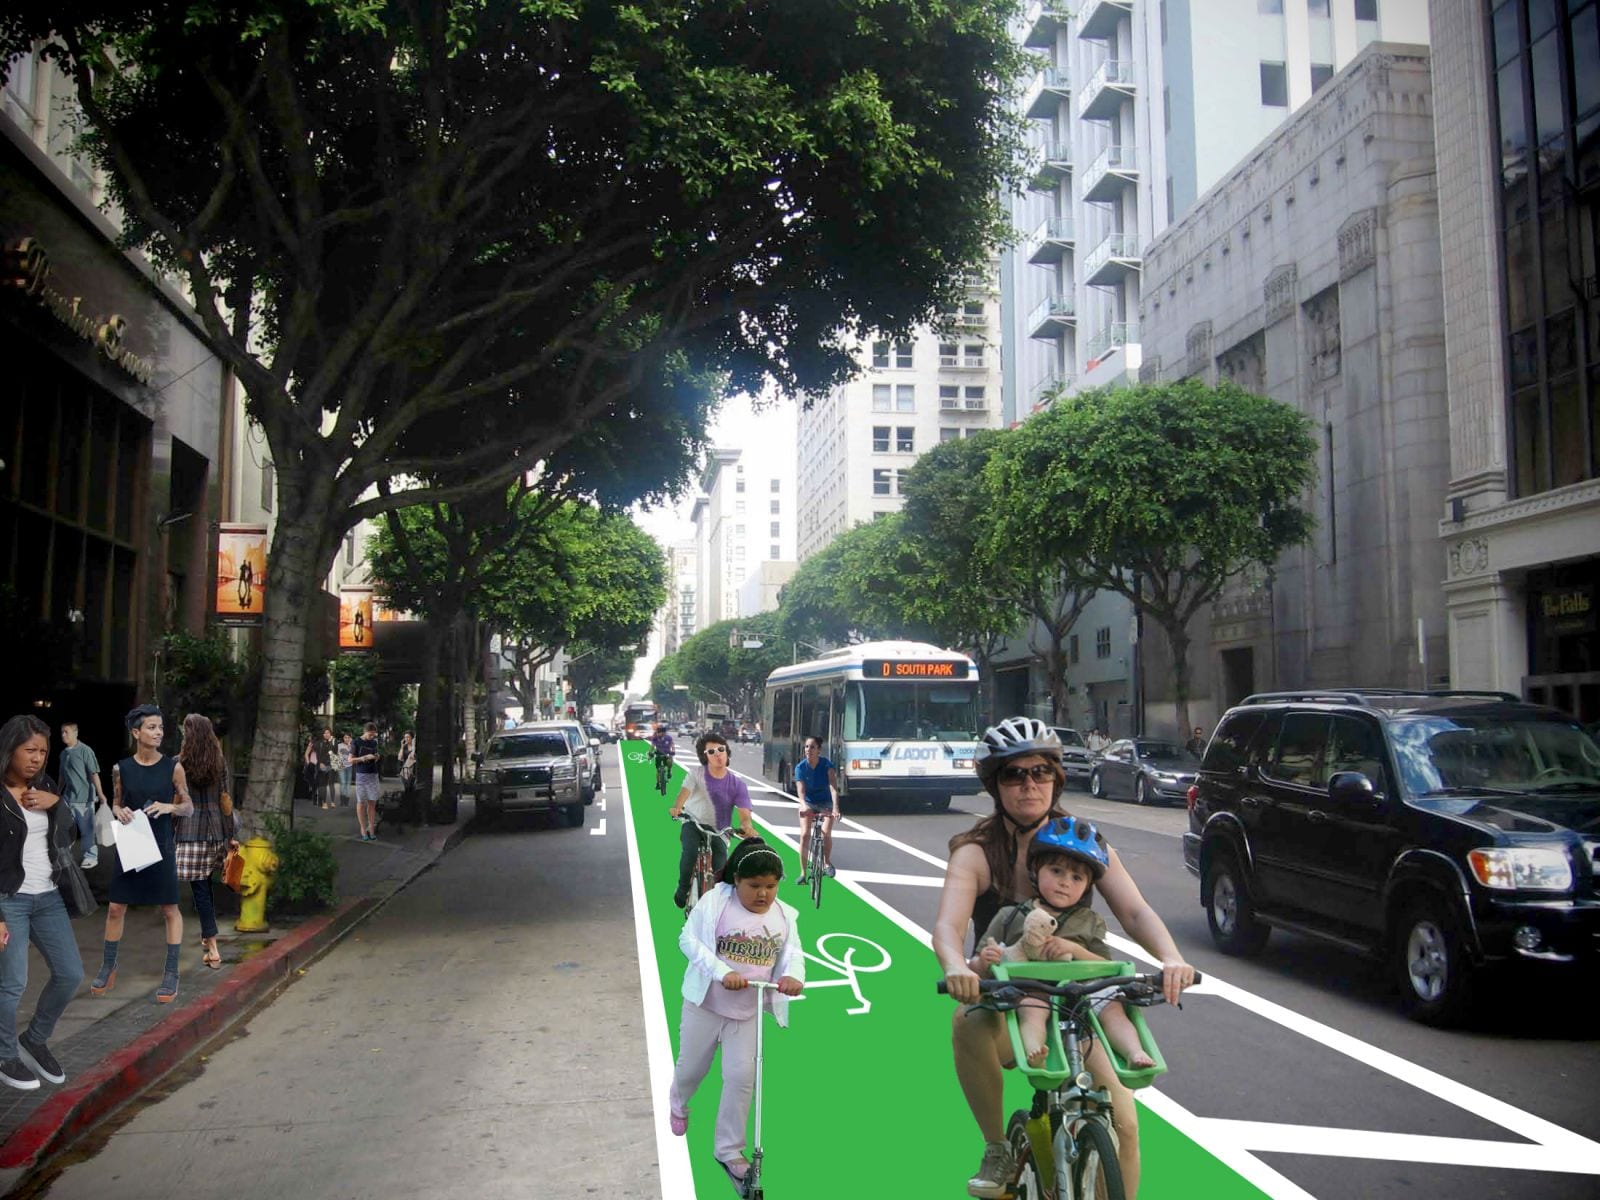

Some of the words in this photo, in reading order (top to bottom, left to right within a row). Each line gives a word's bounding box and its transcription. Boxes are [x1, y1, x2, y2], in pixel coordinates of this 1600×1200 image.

[896, 663, 926, 675] SOUTH
[928, 663, 953, 676] PARK
[894, 747, 938, 760] LADOT
